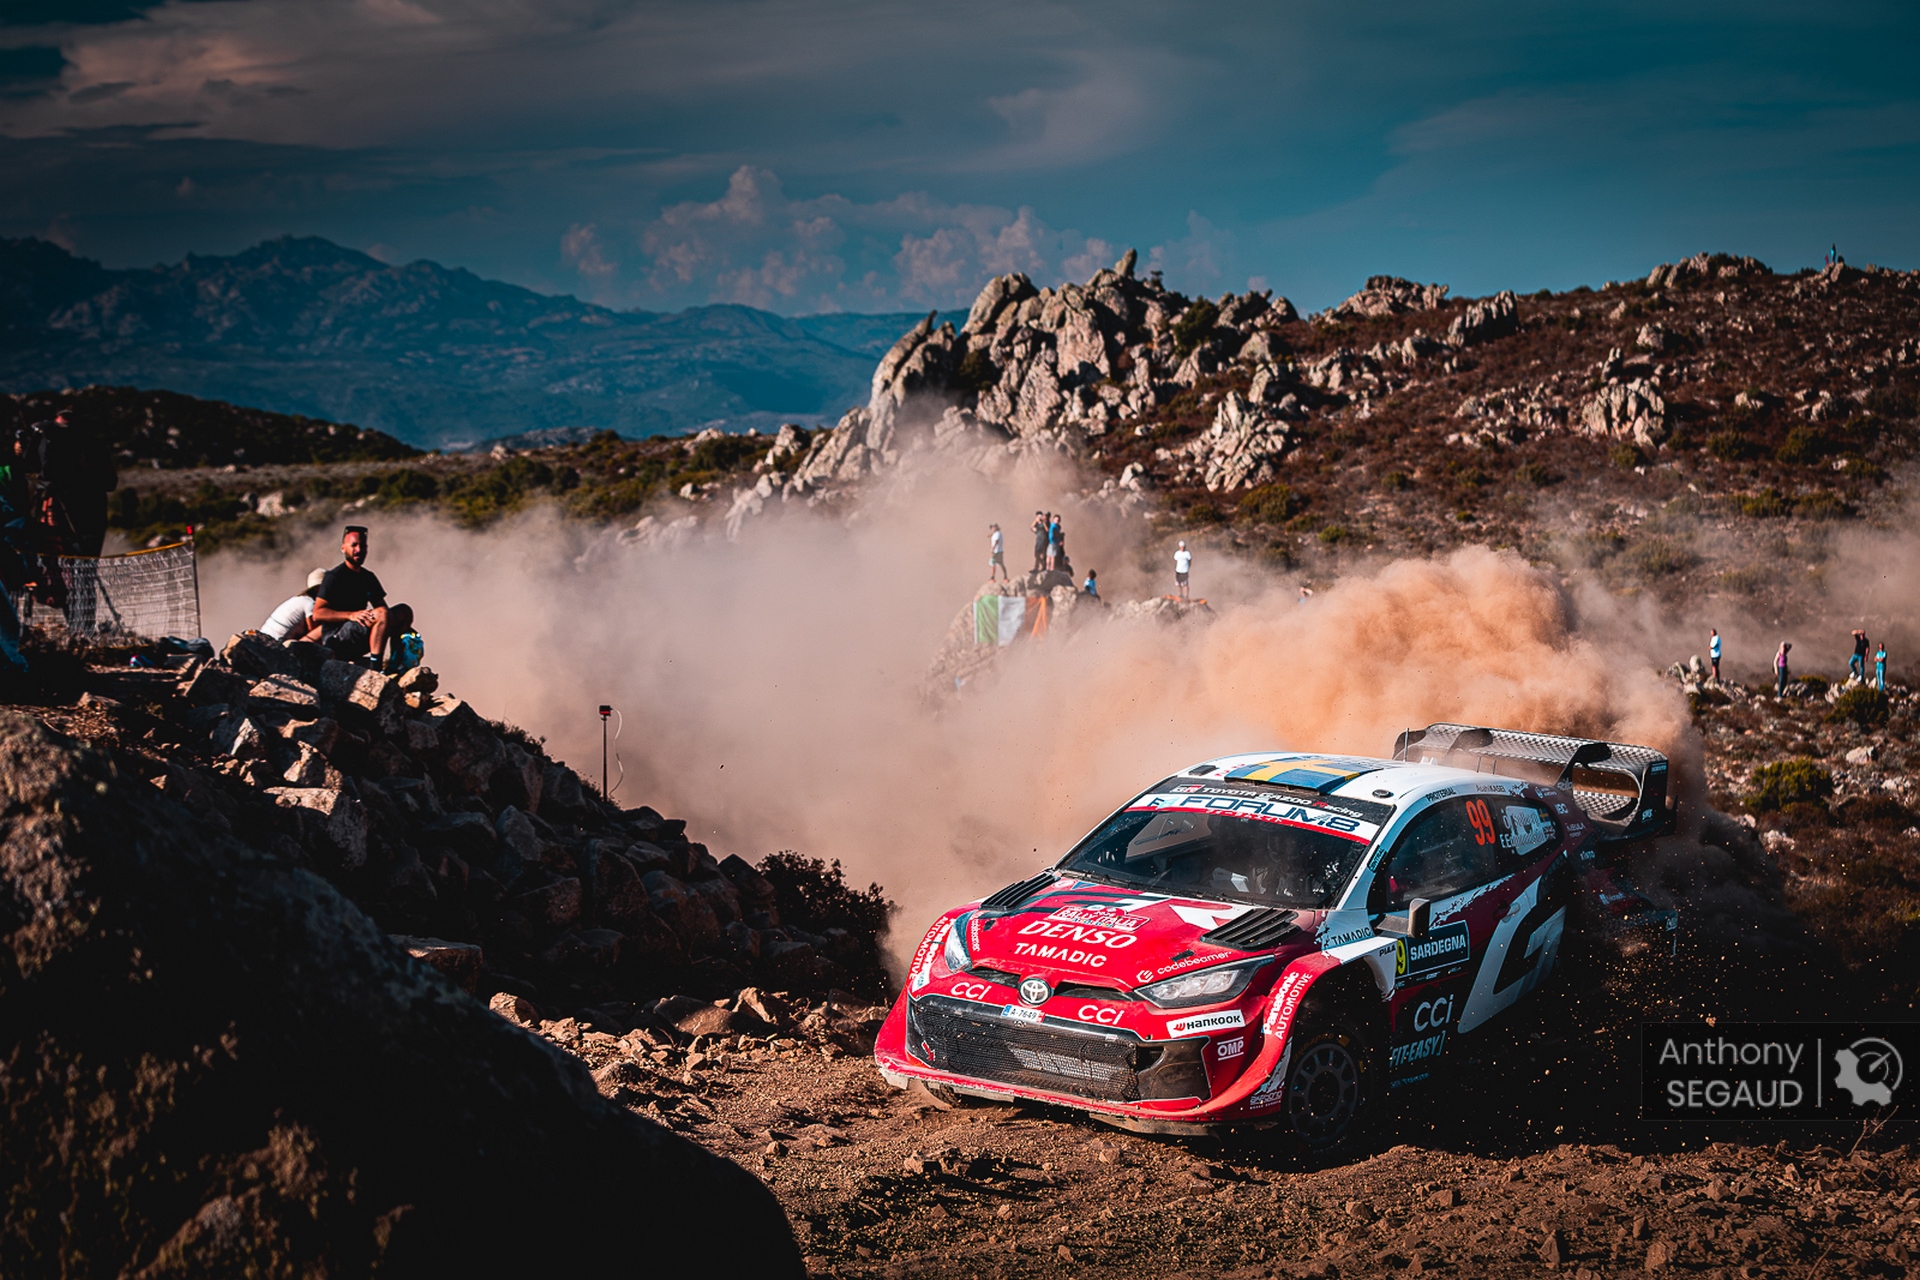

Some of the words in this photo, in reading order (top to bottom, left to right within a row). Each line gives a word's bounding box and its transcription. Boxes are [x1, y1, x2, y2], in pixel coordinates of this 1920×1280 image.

[1179, 795, 1361, 833] FORUM8
[1202, 787, 1257, 798] TOYOTA
[1312, 800, 1364, 819] Racing
[1465, 799, 1496, 846] 99
[1058, 909, 1098, 920] RALLY
[909, 916, 949, 980] AUTOMOTIVE
[1018, 920, 1137, 949] DENSO
[1331, 926, 1372, 946] TAMADIC
[1410, 935, 1467, 962] SARDEGNA
[1014, 942, 1107, 968] TAMADIC
[1157, 951, 1229, 974] codebeamer
[1379, 943, 1396, 957] PIAA
[1263, 971, 1299, 1035] Panasonic
[1274, 973, 1313, 1040] AUTOMOTIVE
[1217, 1040, 1244, 1057] OMP
